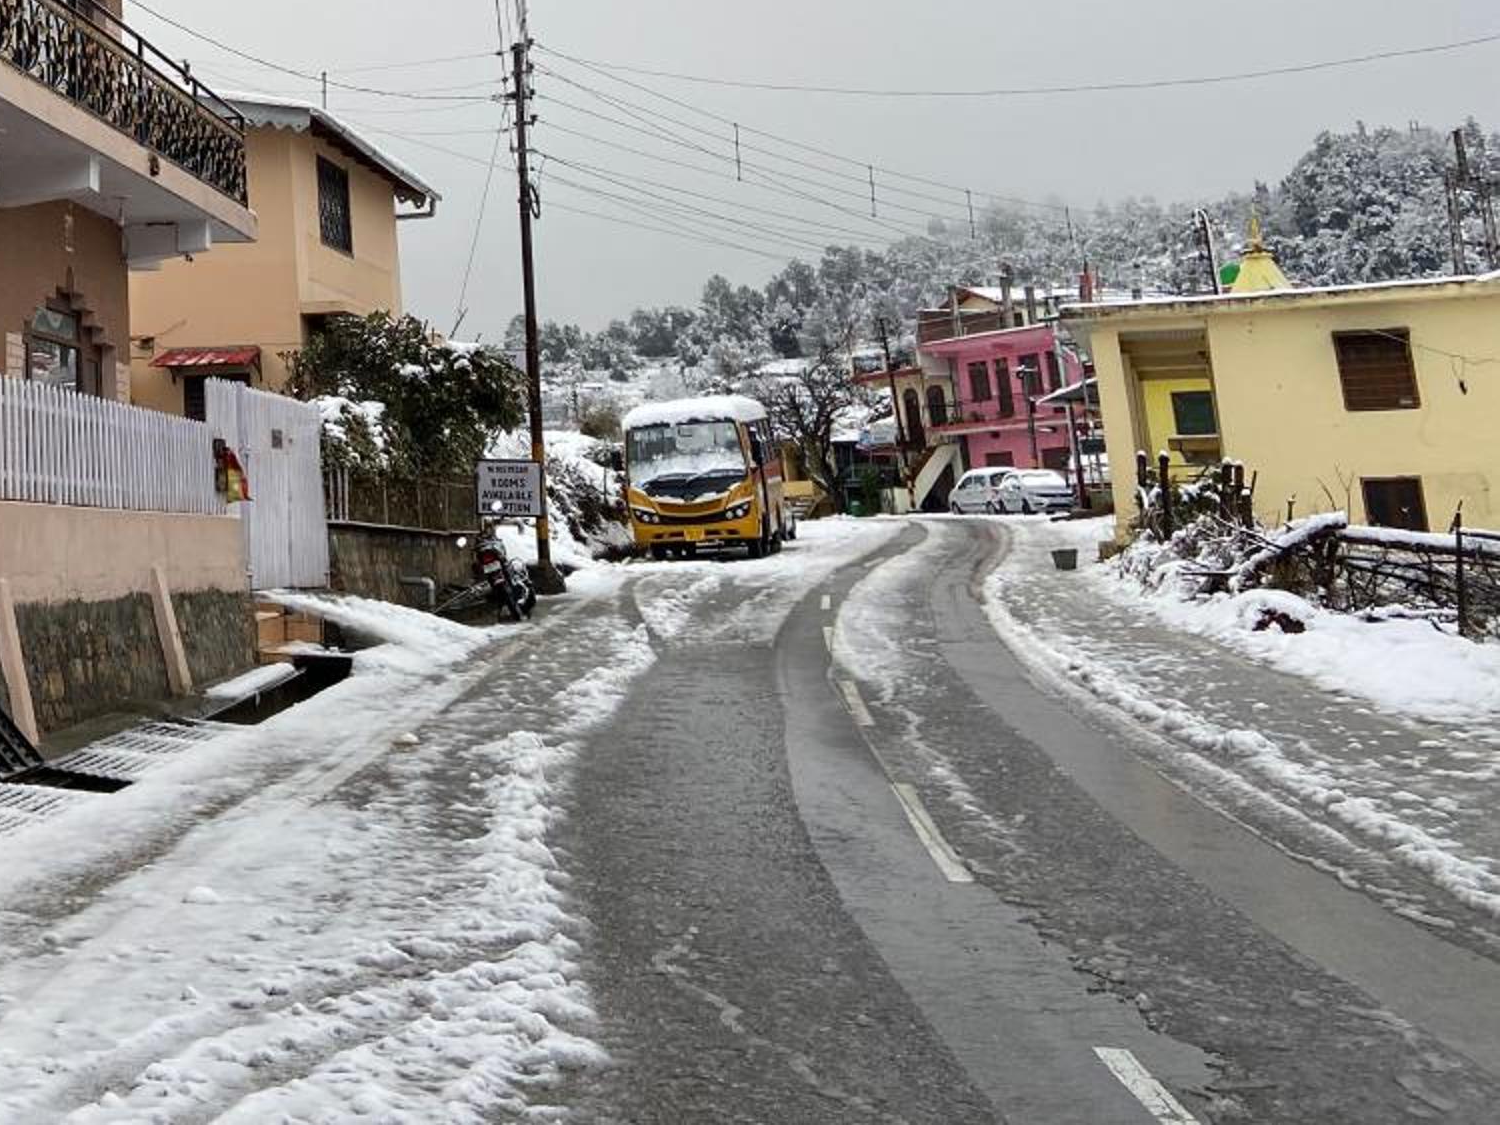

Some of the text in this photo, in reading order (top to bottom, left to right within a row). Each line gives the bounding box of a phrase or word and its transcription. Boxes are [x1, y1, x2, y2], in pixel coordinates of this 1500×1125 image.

[491, 478, 526, 488] ROOMS
[482, 490, 533, 501] AVAILABLE
[482, 501, 531, 513] REPTION
